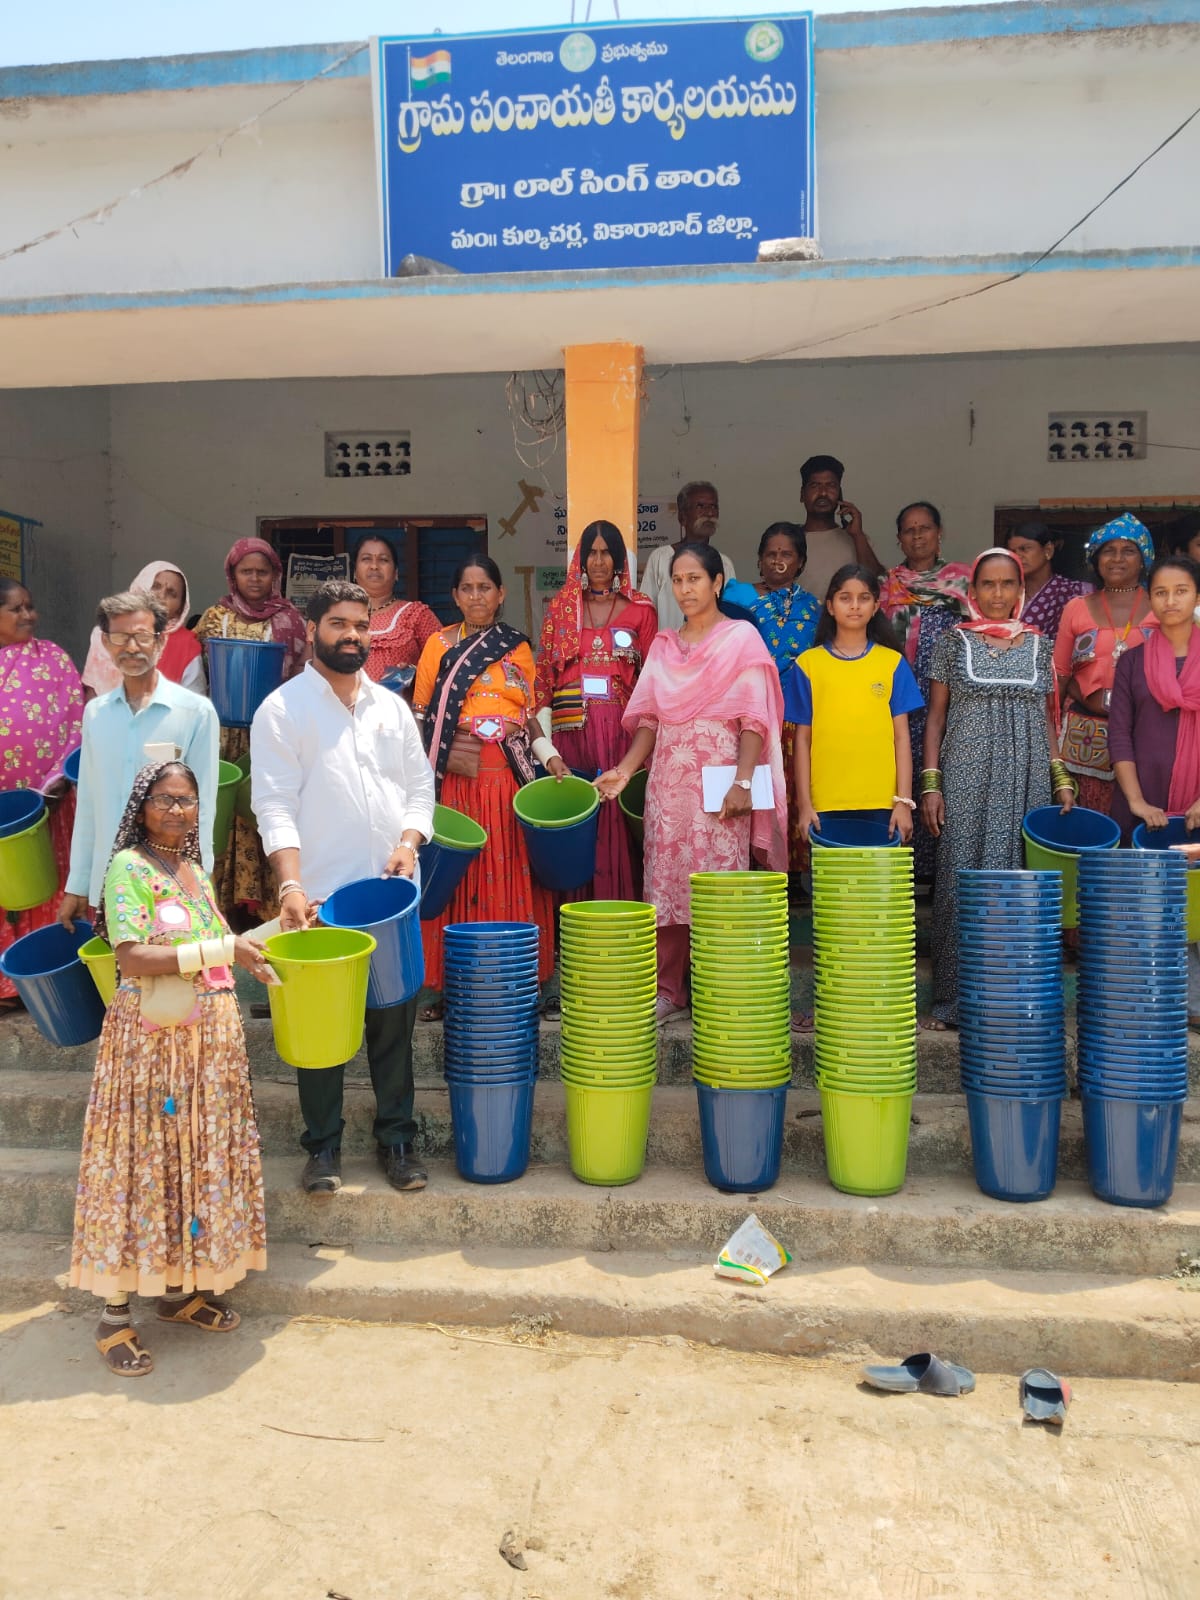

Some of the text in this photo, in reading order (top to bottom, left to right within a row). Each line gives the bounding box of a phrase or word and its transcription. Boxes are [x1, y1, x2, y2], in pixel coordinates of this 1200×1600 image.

[496, 41, 667, 65] తెలంగాణ ప్రభుత్వము
[398, 93, 464, 153] గ్రామ
[471, 75, 615, 133] పంచాయతీ
[514, 168, 575, 198] లాల్
[580, 164, 649, 194] సింగ్
[656, 162, 740, 189] తాండ
[594, 213, 702, 240] వికారాబాద్
